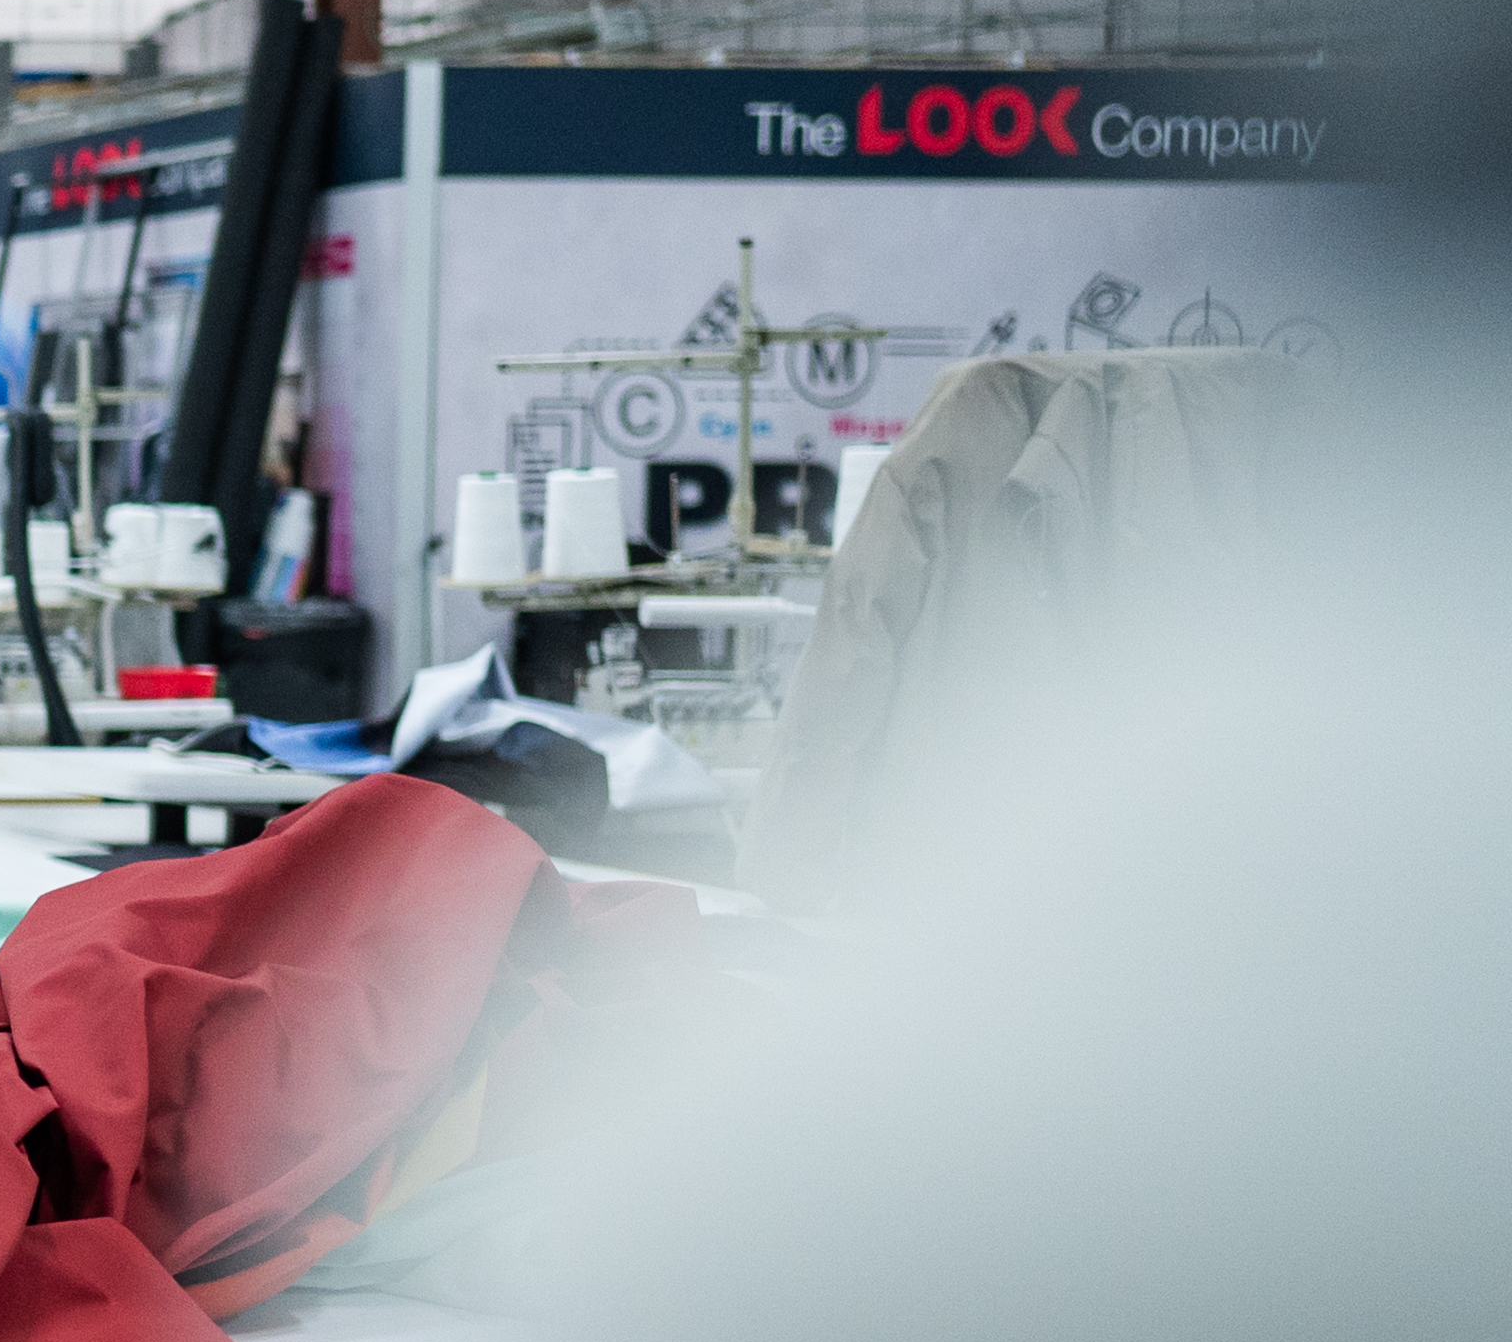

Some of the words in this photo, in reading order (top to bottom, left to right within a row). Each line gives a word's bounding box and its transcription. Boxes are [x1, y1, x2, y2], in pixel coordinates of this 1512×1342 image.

[743, 101, 848, 157] The
[856, 83, 1081, 157] LOOK
[1090, 102, 1326, 167] Company
